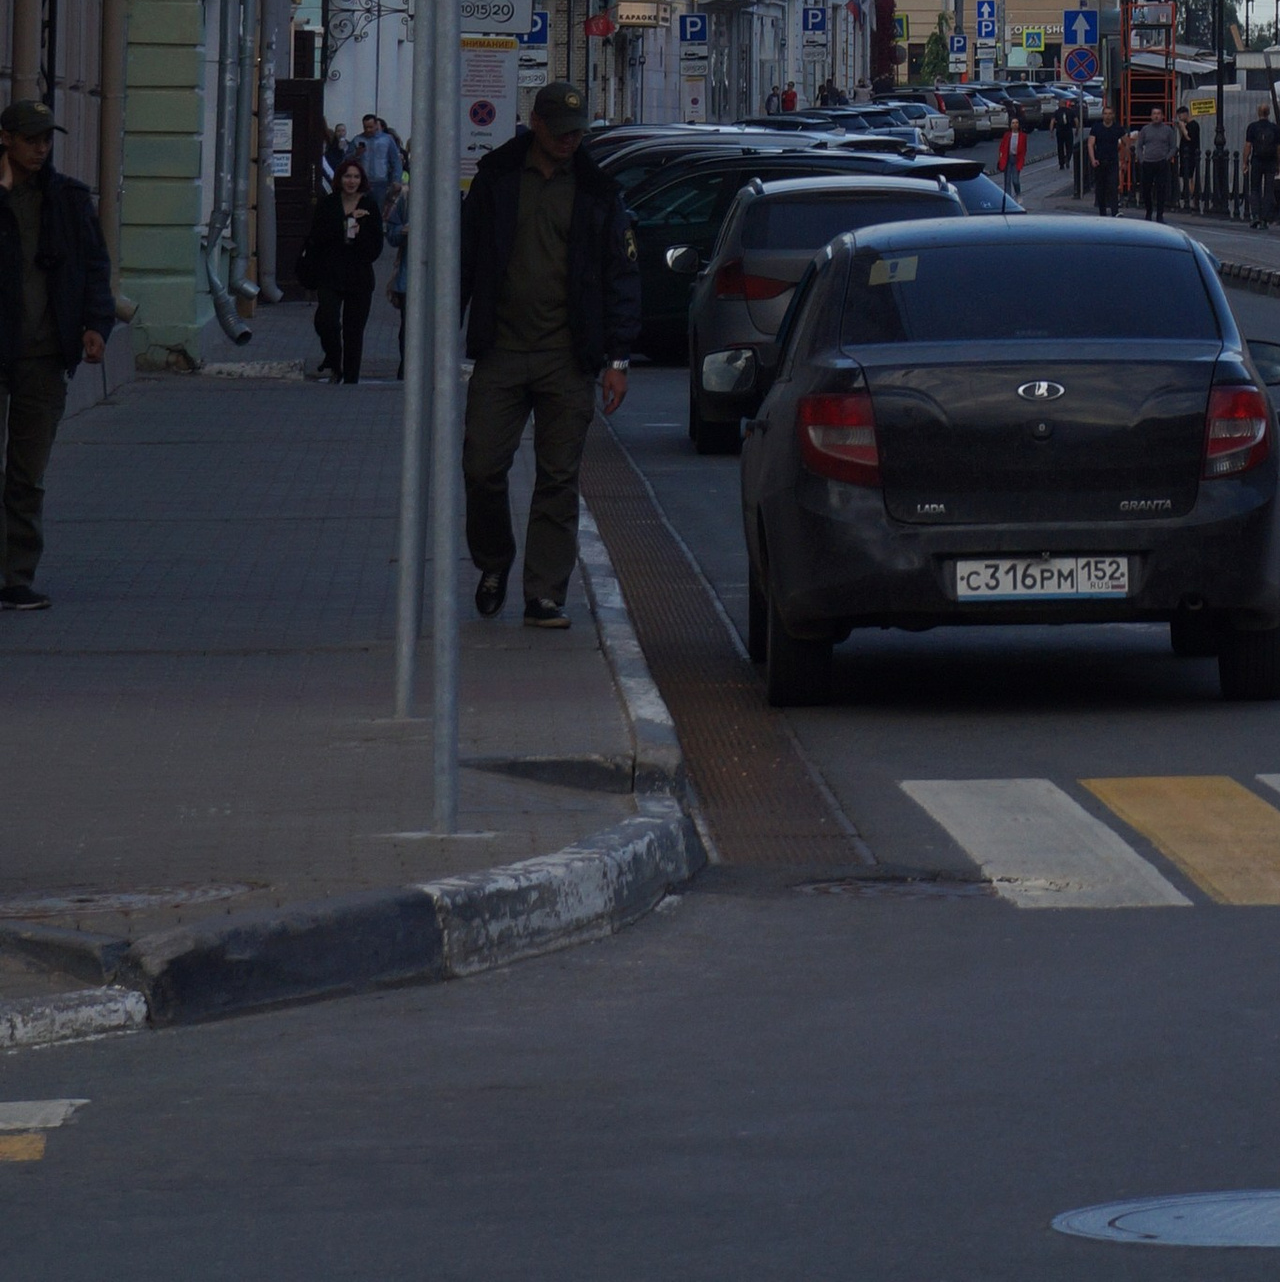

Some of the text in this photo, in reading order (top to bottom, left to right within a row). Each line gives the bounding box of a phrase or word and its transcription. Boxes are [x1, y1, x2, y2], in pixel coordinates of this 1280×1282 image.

[461, 4, 511, 16] 10 15 20
[808, 10, 822, 30] P
[685, 17, 702, 39] P
[981, 22, 993, 37] P
[954, 38, 964, 52] P
[917, 503, 946, 514] LADA
[1119, 499, 1173, 511] GRANTA
[1090, 581, 1110, 589] RUS
